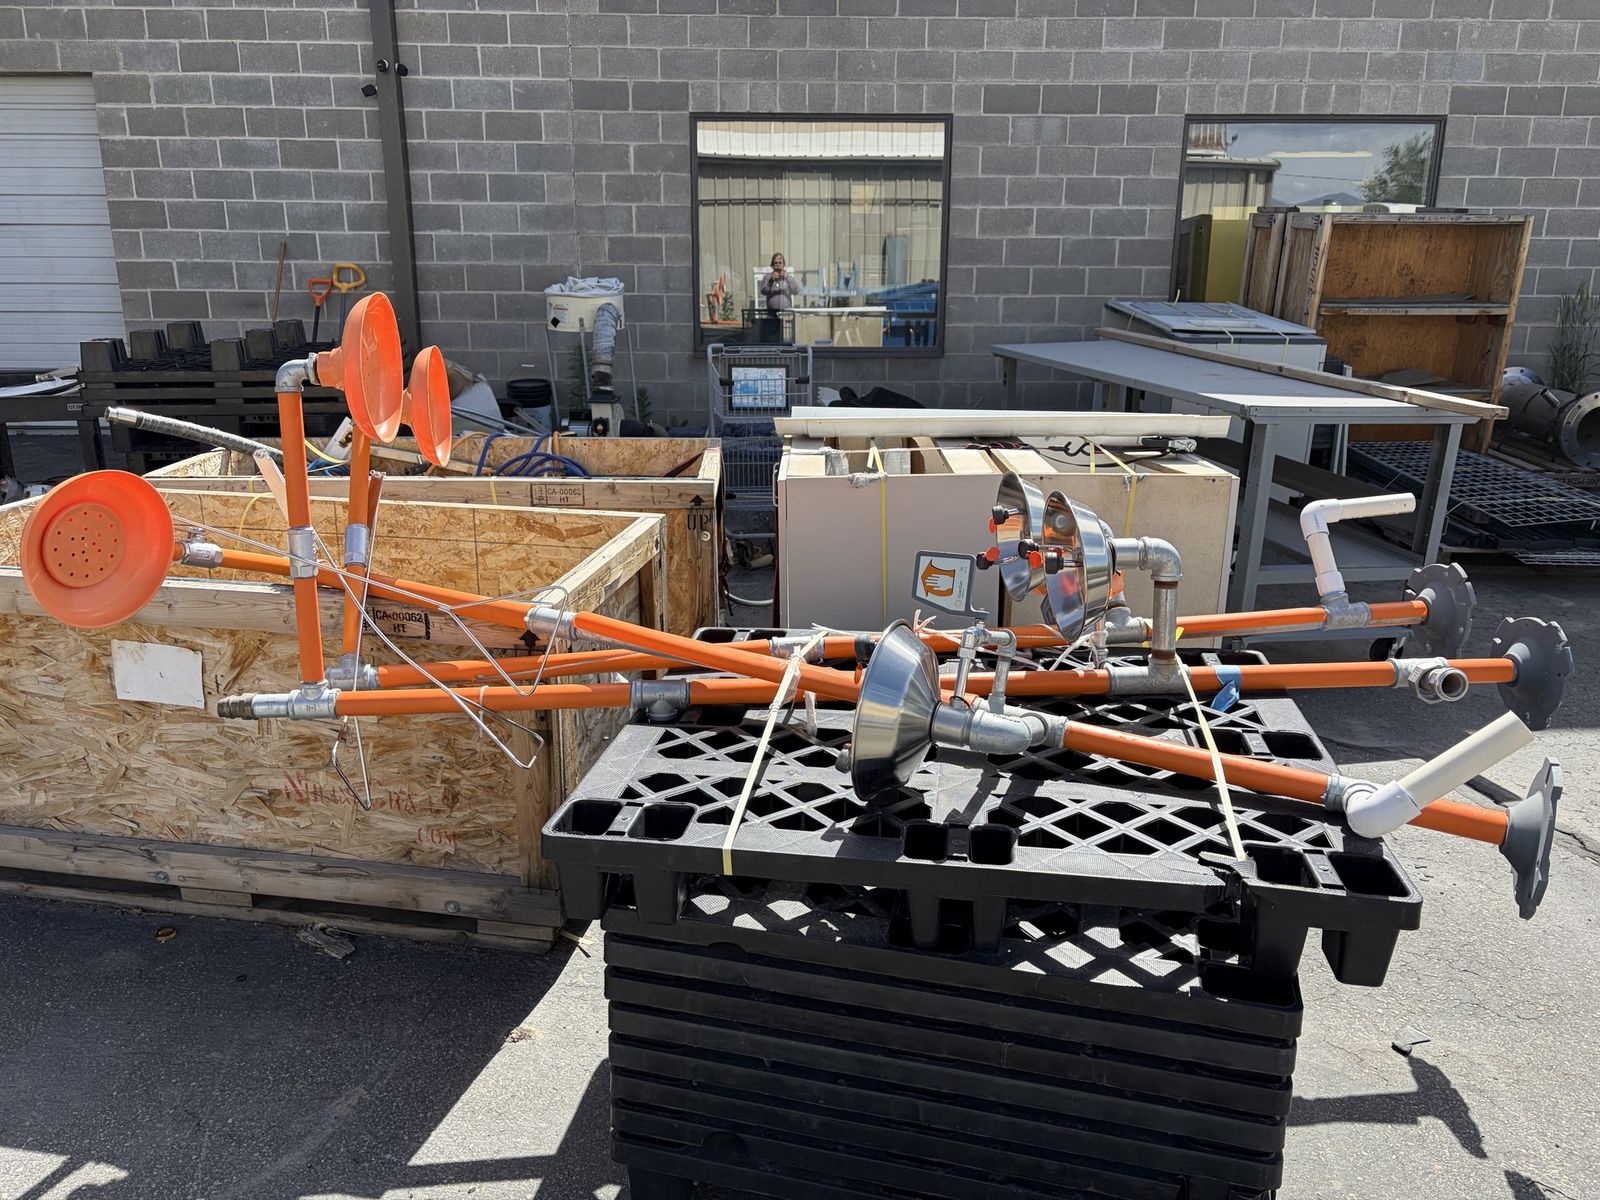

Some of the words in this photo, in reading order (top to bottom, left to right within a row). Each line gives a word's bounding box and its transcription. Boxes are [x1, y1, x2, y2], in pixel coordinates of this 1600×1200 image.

[547, 488, 582, 496] CA-00062
[687, 514, 709, 530] UP
[375, 609, 424, 623] CA-00062
[392, 623, 406, 633] HT
